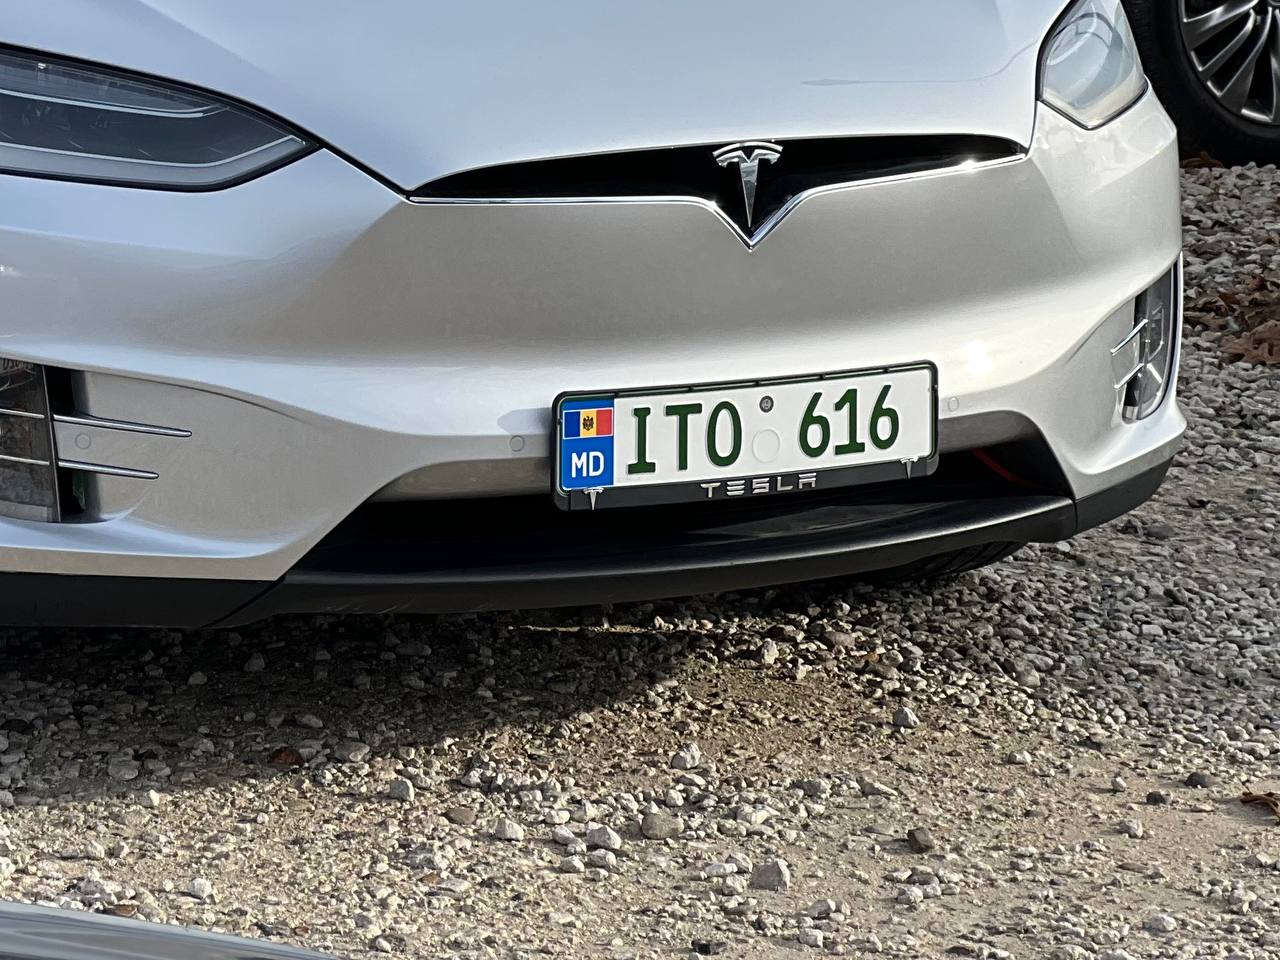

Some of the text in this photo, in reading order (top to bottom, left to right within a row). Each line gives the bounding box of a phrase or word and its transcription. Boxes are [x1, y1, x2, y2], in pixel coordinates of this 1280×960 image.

[628, 384, 900, 475] ITO 616
[571, 451, 605, 479] MD
[700, 472, 818, 499] TESLA
